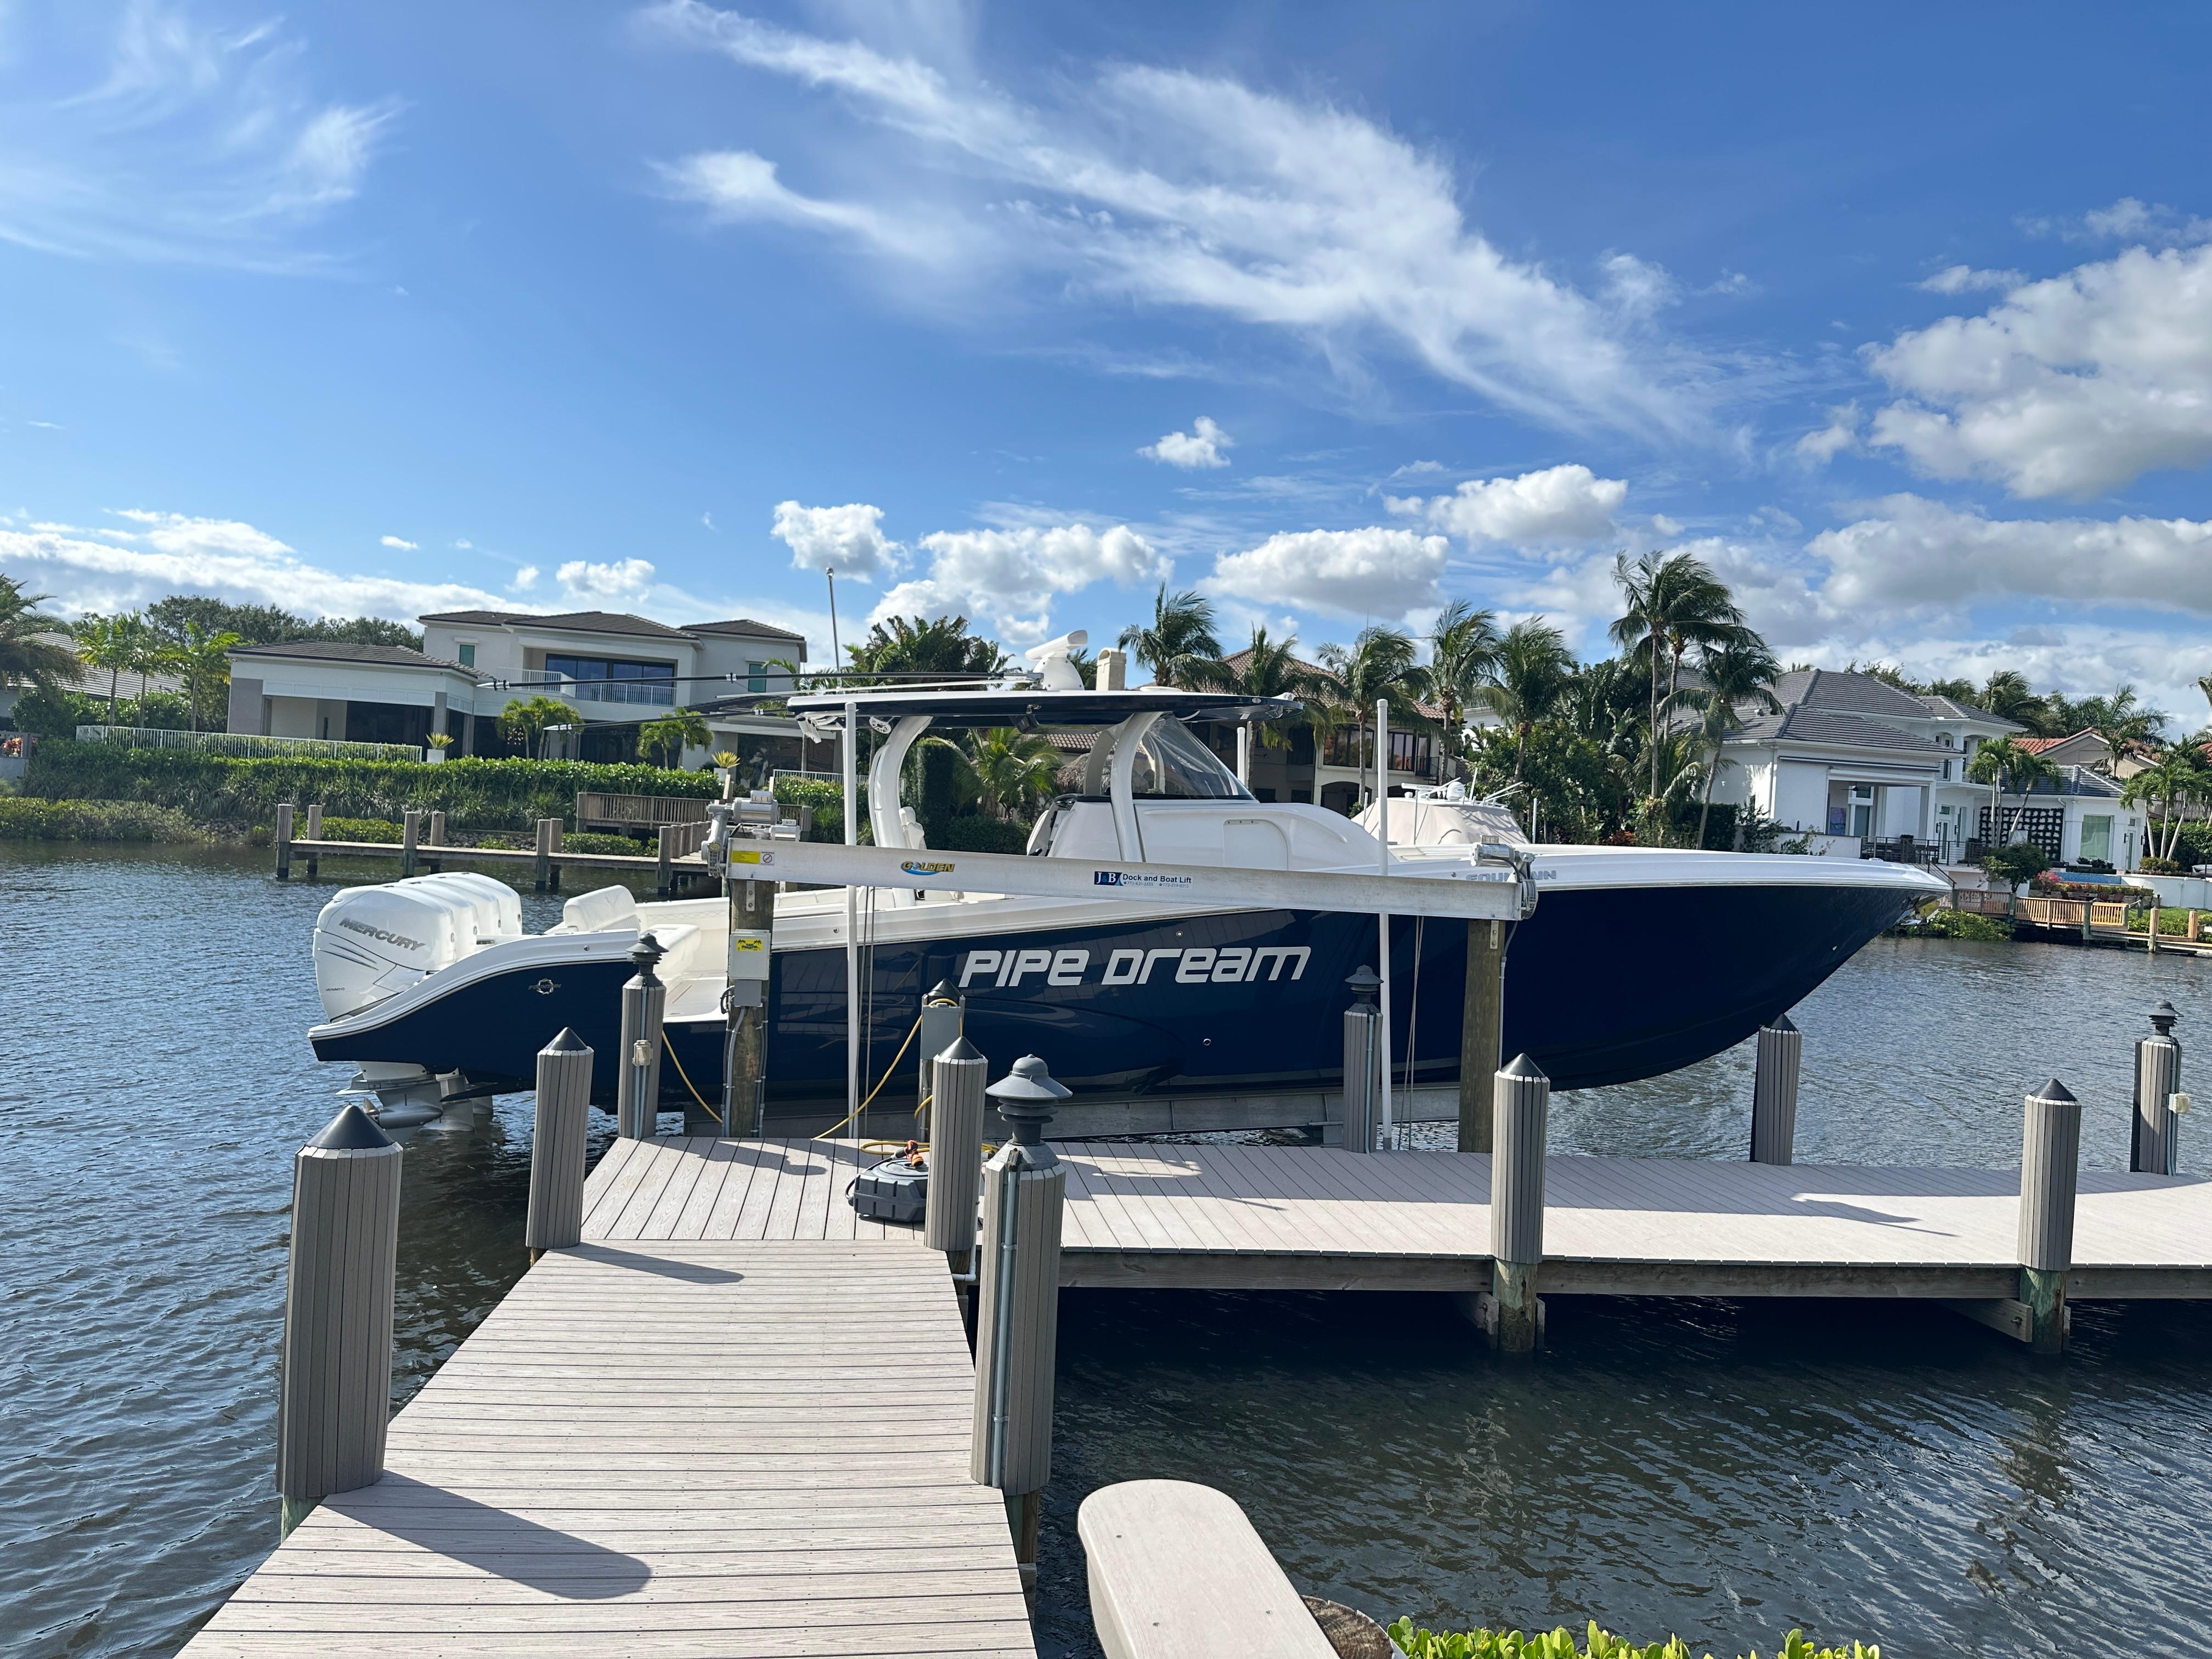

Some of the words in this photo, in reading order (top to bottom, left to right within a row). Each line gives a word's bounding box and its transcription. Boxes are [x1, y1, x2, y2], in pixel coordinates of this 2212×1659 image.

[902, 861, 955, 872] GOLDEN
[1466, 870, 1556, 882] FOUAIN
[338, 917, 426, 951] MERCURY
